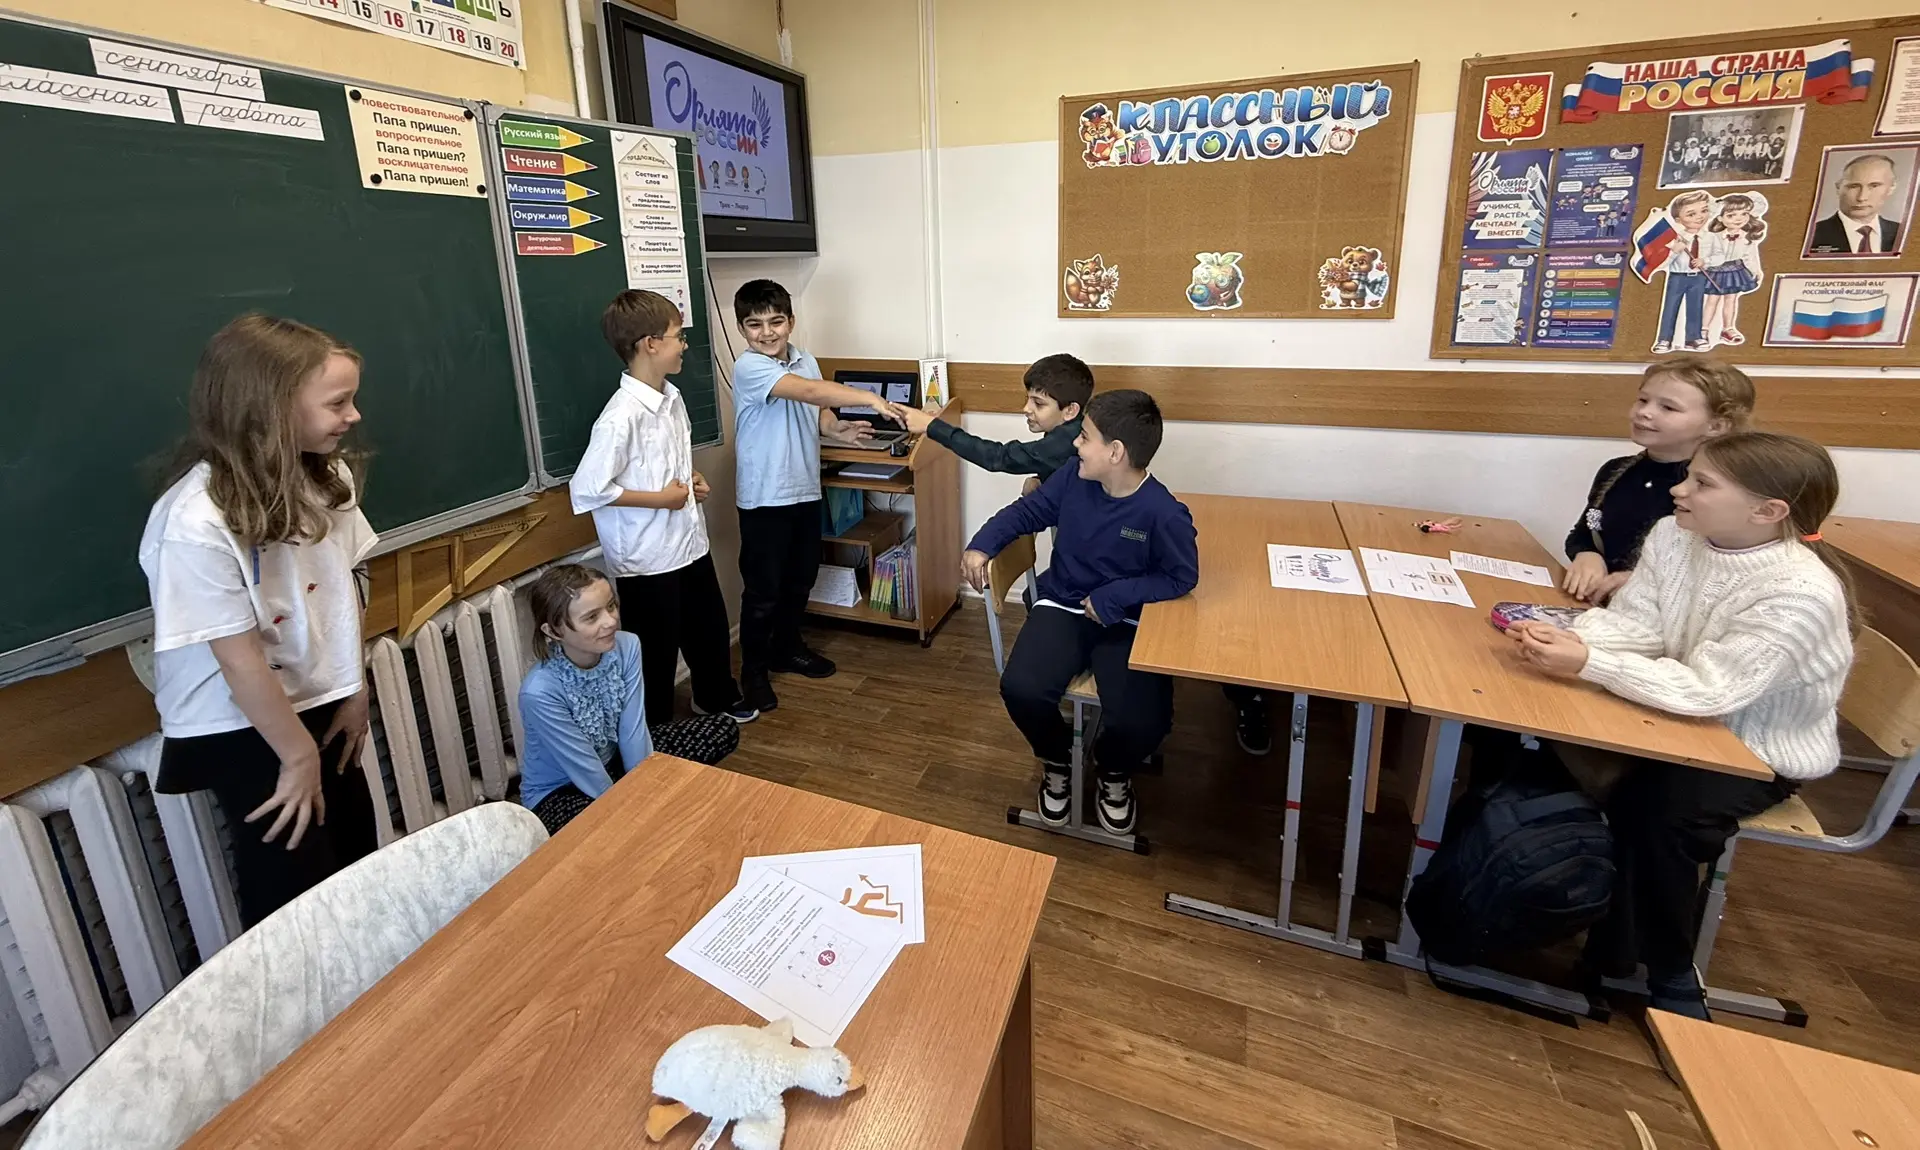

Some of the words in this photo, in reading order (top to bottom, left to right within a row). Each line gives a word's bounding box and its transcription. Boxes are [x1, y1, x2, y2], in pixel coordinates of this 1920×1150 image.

[353, 0, 372, 19] 15
[384, 10, 404, 28] 16
[416, 19, 435, 36] 17
[447, 27, 466, 44] 18
[475, 35, 492, 51] 19
[500, 42, 515, 58] 20
[1623, 60, 1698, 84] НАША
[1711, 50, 1807, 76] СТРАНА
[663, 60, 757, 138] Орлята
[1618, 70, 1807, 112] РОССИЯ
[198, 101, 306, 128] работа
[362, 98, 466, 123] повествовательное
[1119, 80, 1391, 134] КЛАССНЫЙ
[373, 112, 406, 128] Папа
[410, 121, 462, 136] пришел.
[503, 127, 543, 139] Русский
[544, 132, 568, 141] язык
[376, 129, 463, 149] вопросительное
[1151, 123, 1323, 162] УГОЛОК
[377, 141, 410, 156] Папа
[413, 149, 466, 163] пришел?
[510, 154, 557, 169] Чтение
[378, 157, 469, 174] восклицательное
[635, 171, 661, 179] Состоит
[383, 169, 416, 183] Папа
[420, 175, 469, 187] пришел!
[1479, 170, 1529, 191] Орлята
[508, 183, 567, 195] Математика
[514, 210, 568, 222] Окруж.мир
[1475, 220, 1517, 228] МЕЧТАЕМ
[1494, 211, 1531, 219] РАСТЁМ,
[1487, 229, 1524, 237] ВМЕСТЕ!
